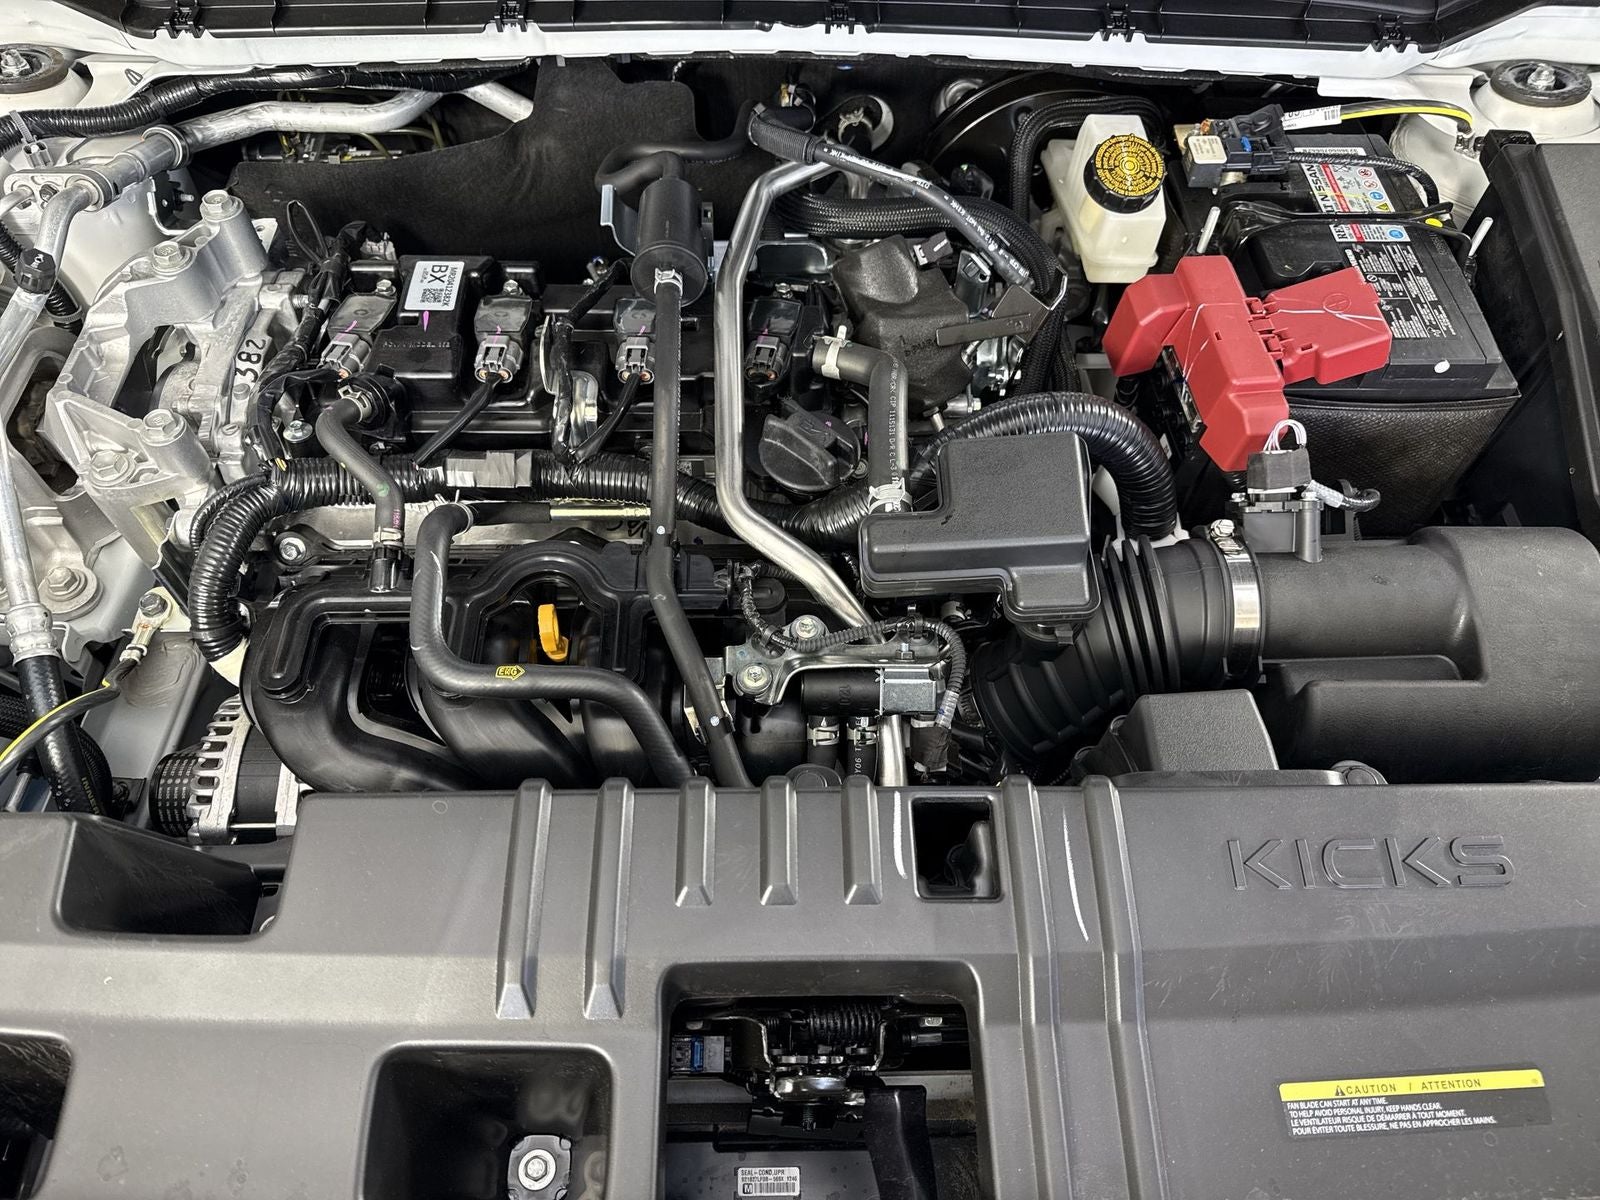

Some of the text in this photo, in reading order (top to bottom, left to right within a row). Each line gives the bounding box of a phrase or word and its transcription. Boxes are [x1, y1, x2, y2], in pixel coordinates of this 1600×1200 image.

[428, 264, 450, 284] BX
[235, 339, 266, 383] 382
[1227, 836, 1516, 890] KICKS
[1346, 1083, 1397, 1095] CAUTION
[1421, 1079, 1482, 1090] ATTENTION
[1300, 1101, 1319, 1109] BLADE
[1314, 1108, 1332, 1116] AVOID
[1333, 1107, 1364, 1115] PERSONAL
[1401, 1103, 1421, 1112] HANDS
[1422, 1102, 1442, 1110] CLEAR.
[1292, 1127, 1312, 1135] POUR
[1312, 1124, 1334, 1134] ÉVITER
[1335, 1124, 1355, 1133] TOUTE
[1423, 1118, 1460, 1128] APPROCHER
[1461, 1117, 1472, 1125] LES
[1473, 1116, 1498, 1124] MAINS.
[1300, 1117, 1341, 1126] VENTILATEUR
[1342, 1116, 1365, 1124] RISQUE
[1377, 1112, 1411, 1122] DÉMARRER
[1418, 1111, 1435, 1119] TOUT
[1435, 1109, 1467, 1118] MOMENT.
